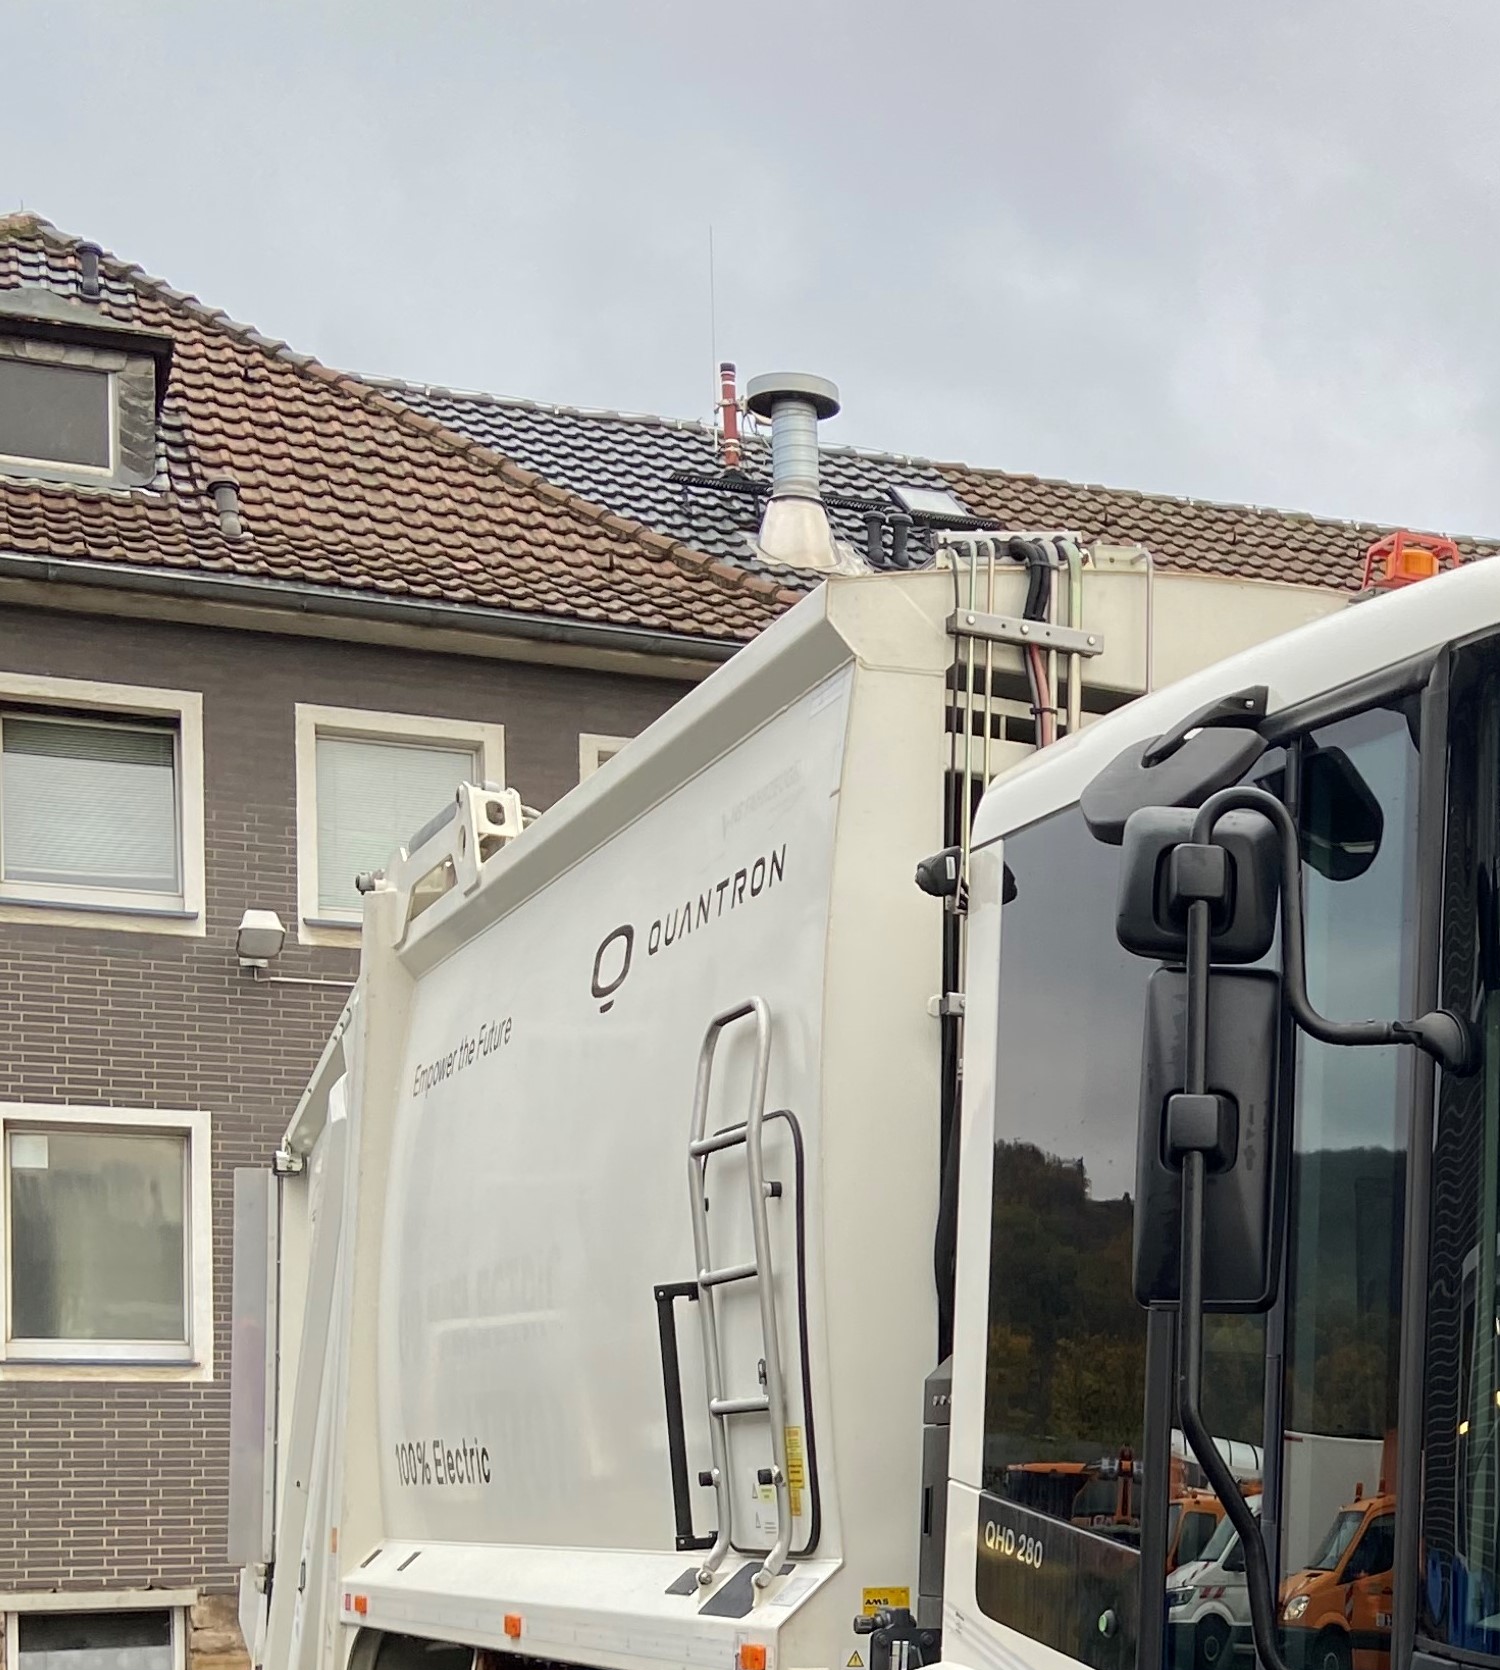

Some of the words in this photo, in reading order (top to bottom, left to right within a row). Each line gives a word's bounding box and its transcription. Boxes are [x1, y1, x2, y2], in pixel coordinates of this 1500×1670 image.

[648, 843, 787, 955] QUANTRON
[413, 1050, 457, 1099] Empower
[458, 1035, 475, 1071] the
[477, 1017, 512, 1060] Future
[395, 1441, 432, 1486] 100%
[433, 1437, 491, 1485] Electric
[985, 1520, 1015, 1555] QHD
[1016, 1533, 1043, 1569] 280
